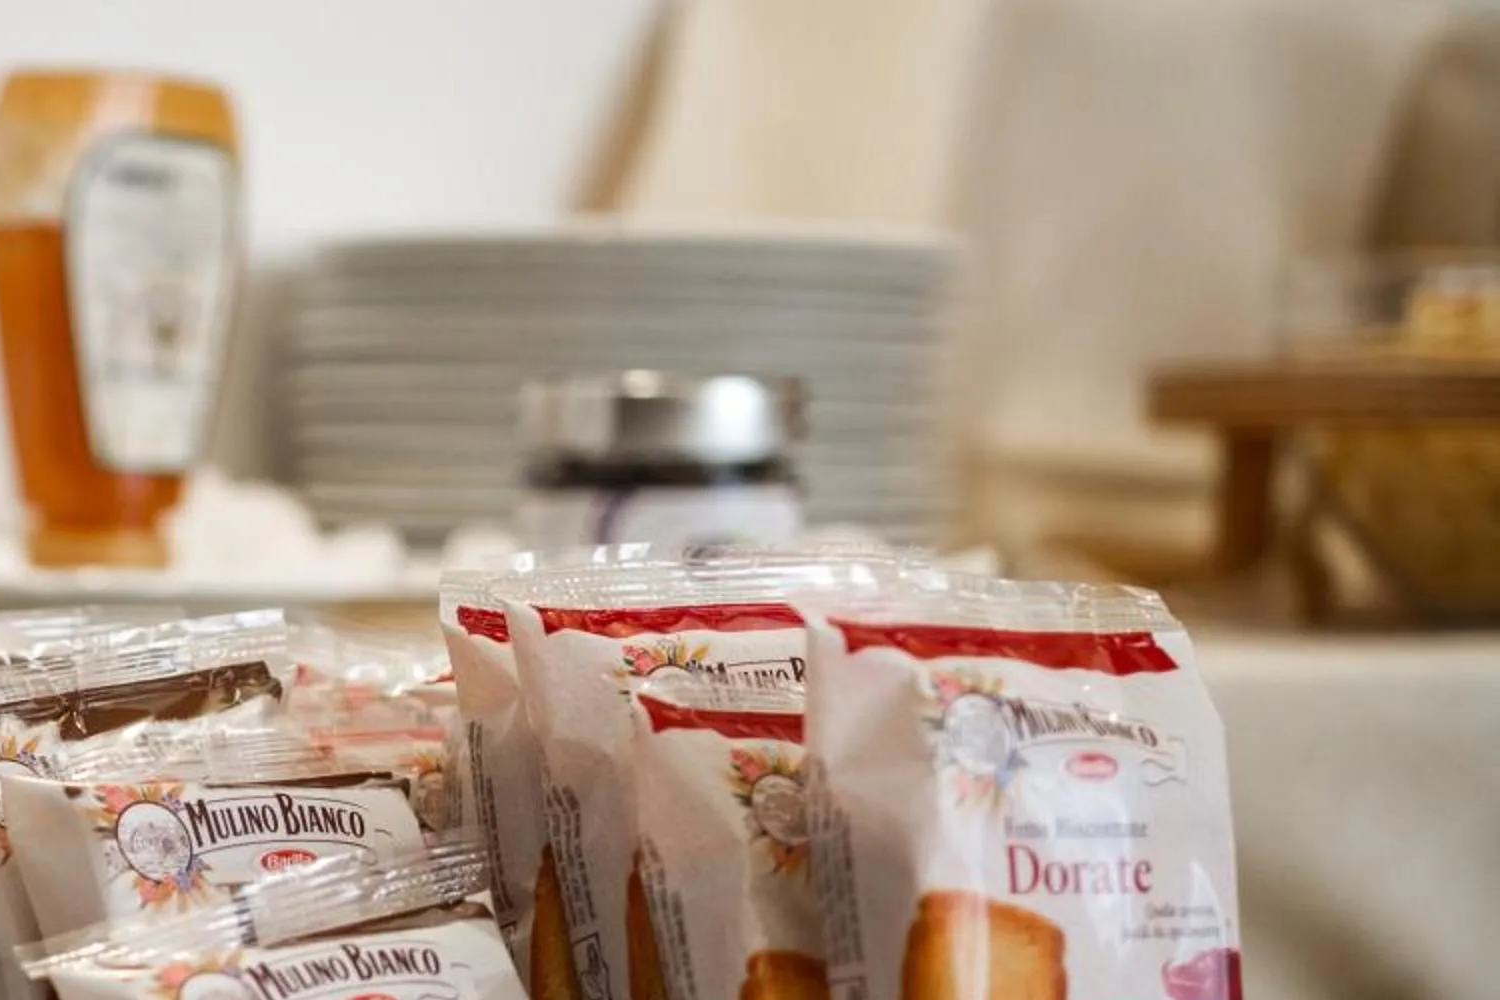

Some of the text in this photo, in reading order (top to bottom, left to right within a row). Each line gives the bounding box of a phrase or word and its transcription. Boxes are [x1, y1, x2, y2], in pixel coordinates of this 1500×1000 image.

[184, 793, 365, 848] MULINO BIANCO
[1006, 845, 1154, 896] Dorate
[340, 943, 441, 982] BIANCO
